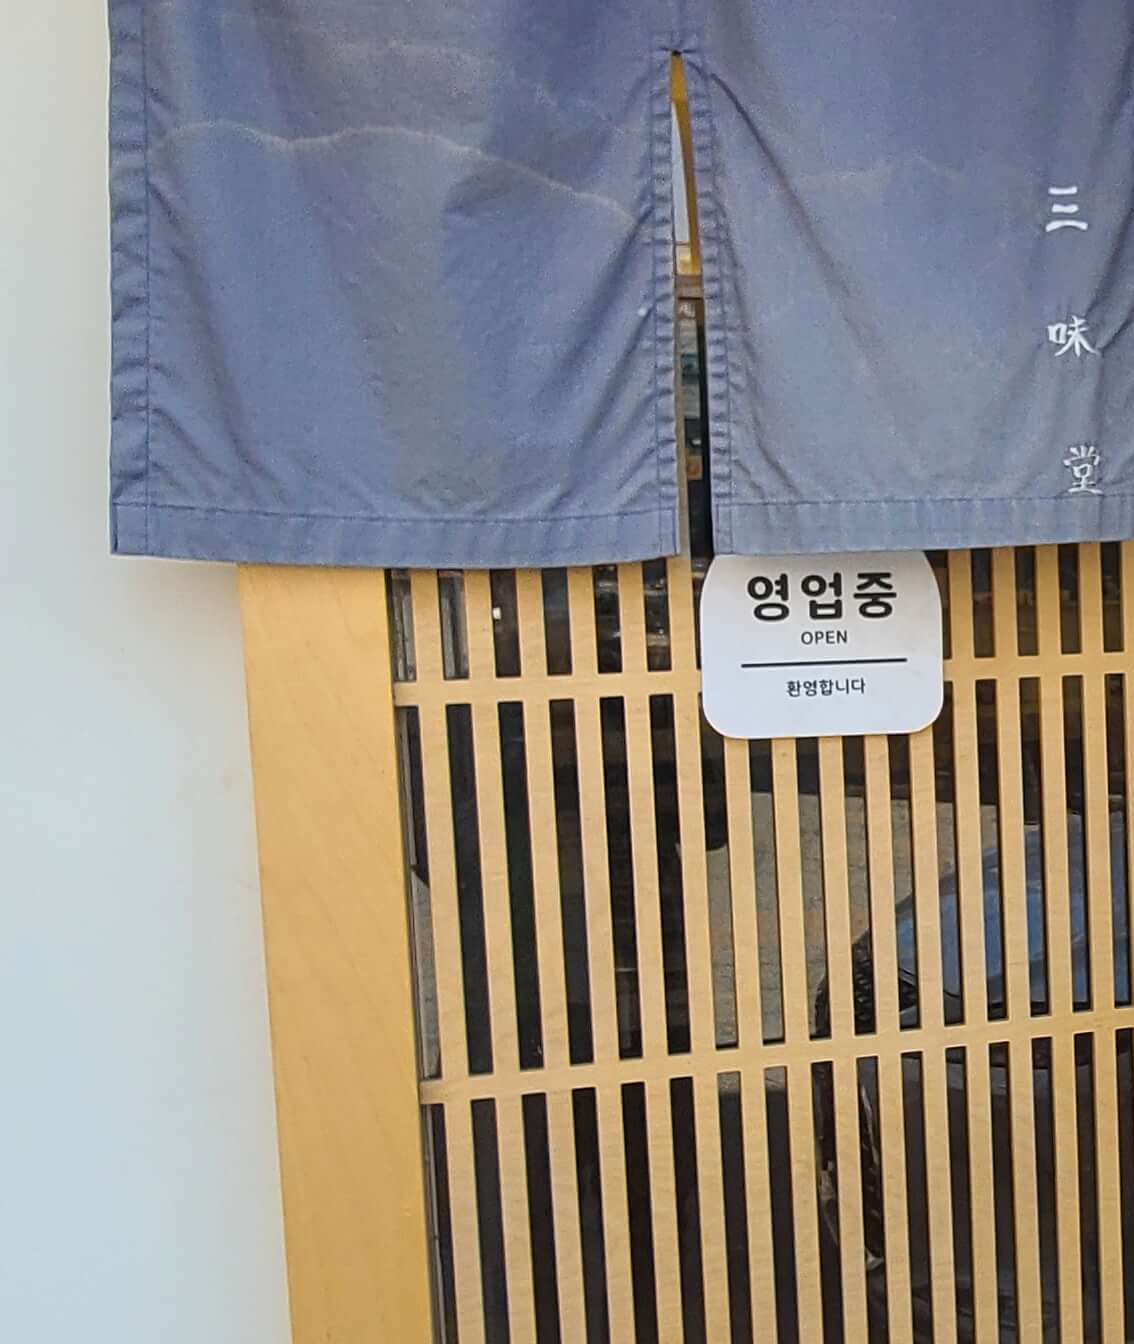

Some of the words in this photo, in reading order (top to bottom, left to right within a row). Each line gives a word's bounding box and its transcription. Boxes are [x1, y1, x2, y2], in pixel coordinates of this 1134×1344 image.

[1045, 184, 1104, 495] 三味堂
[747, 572, 897, 622] 영업중
[800, 630, 848, 645] OPEN
[786, 677, 866, 697] 환영합니다
